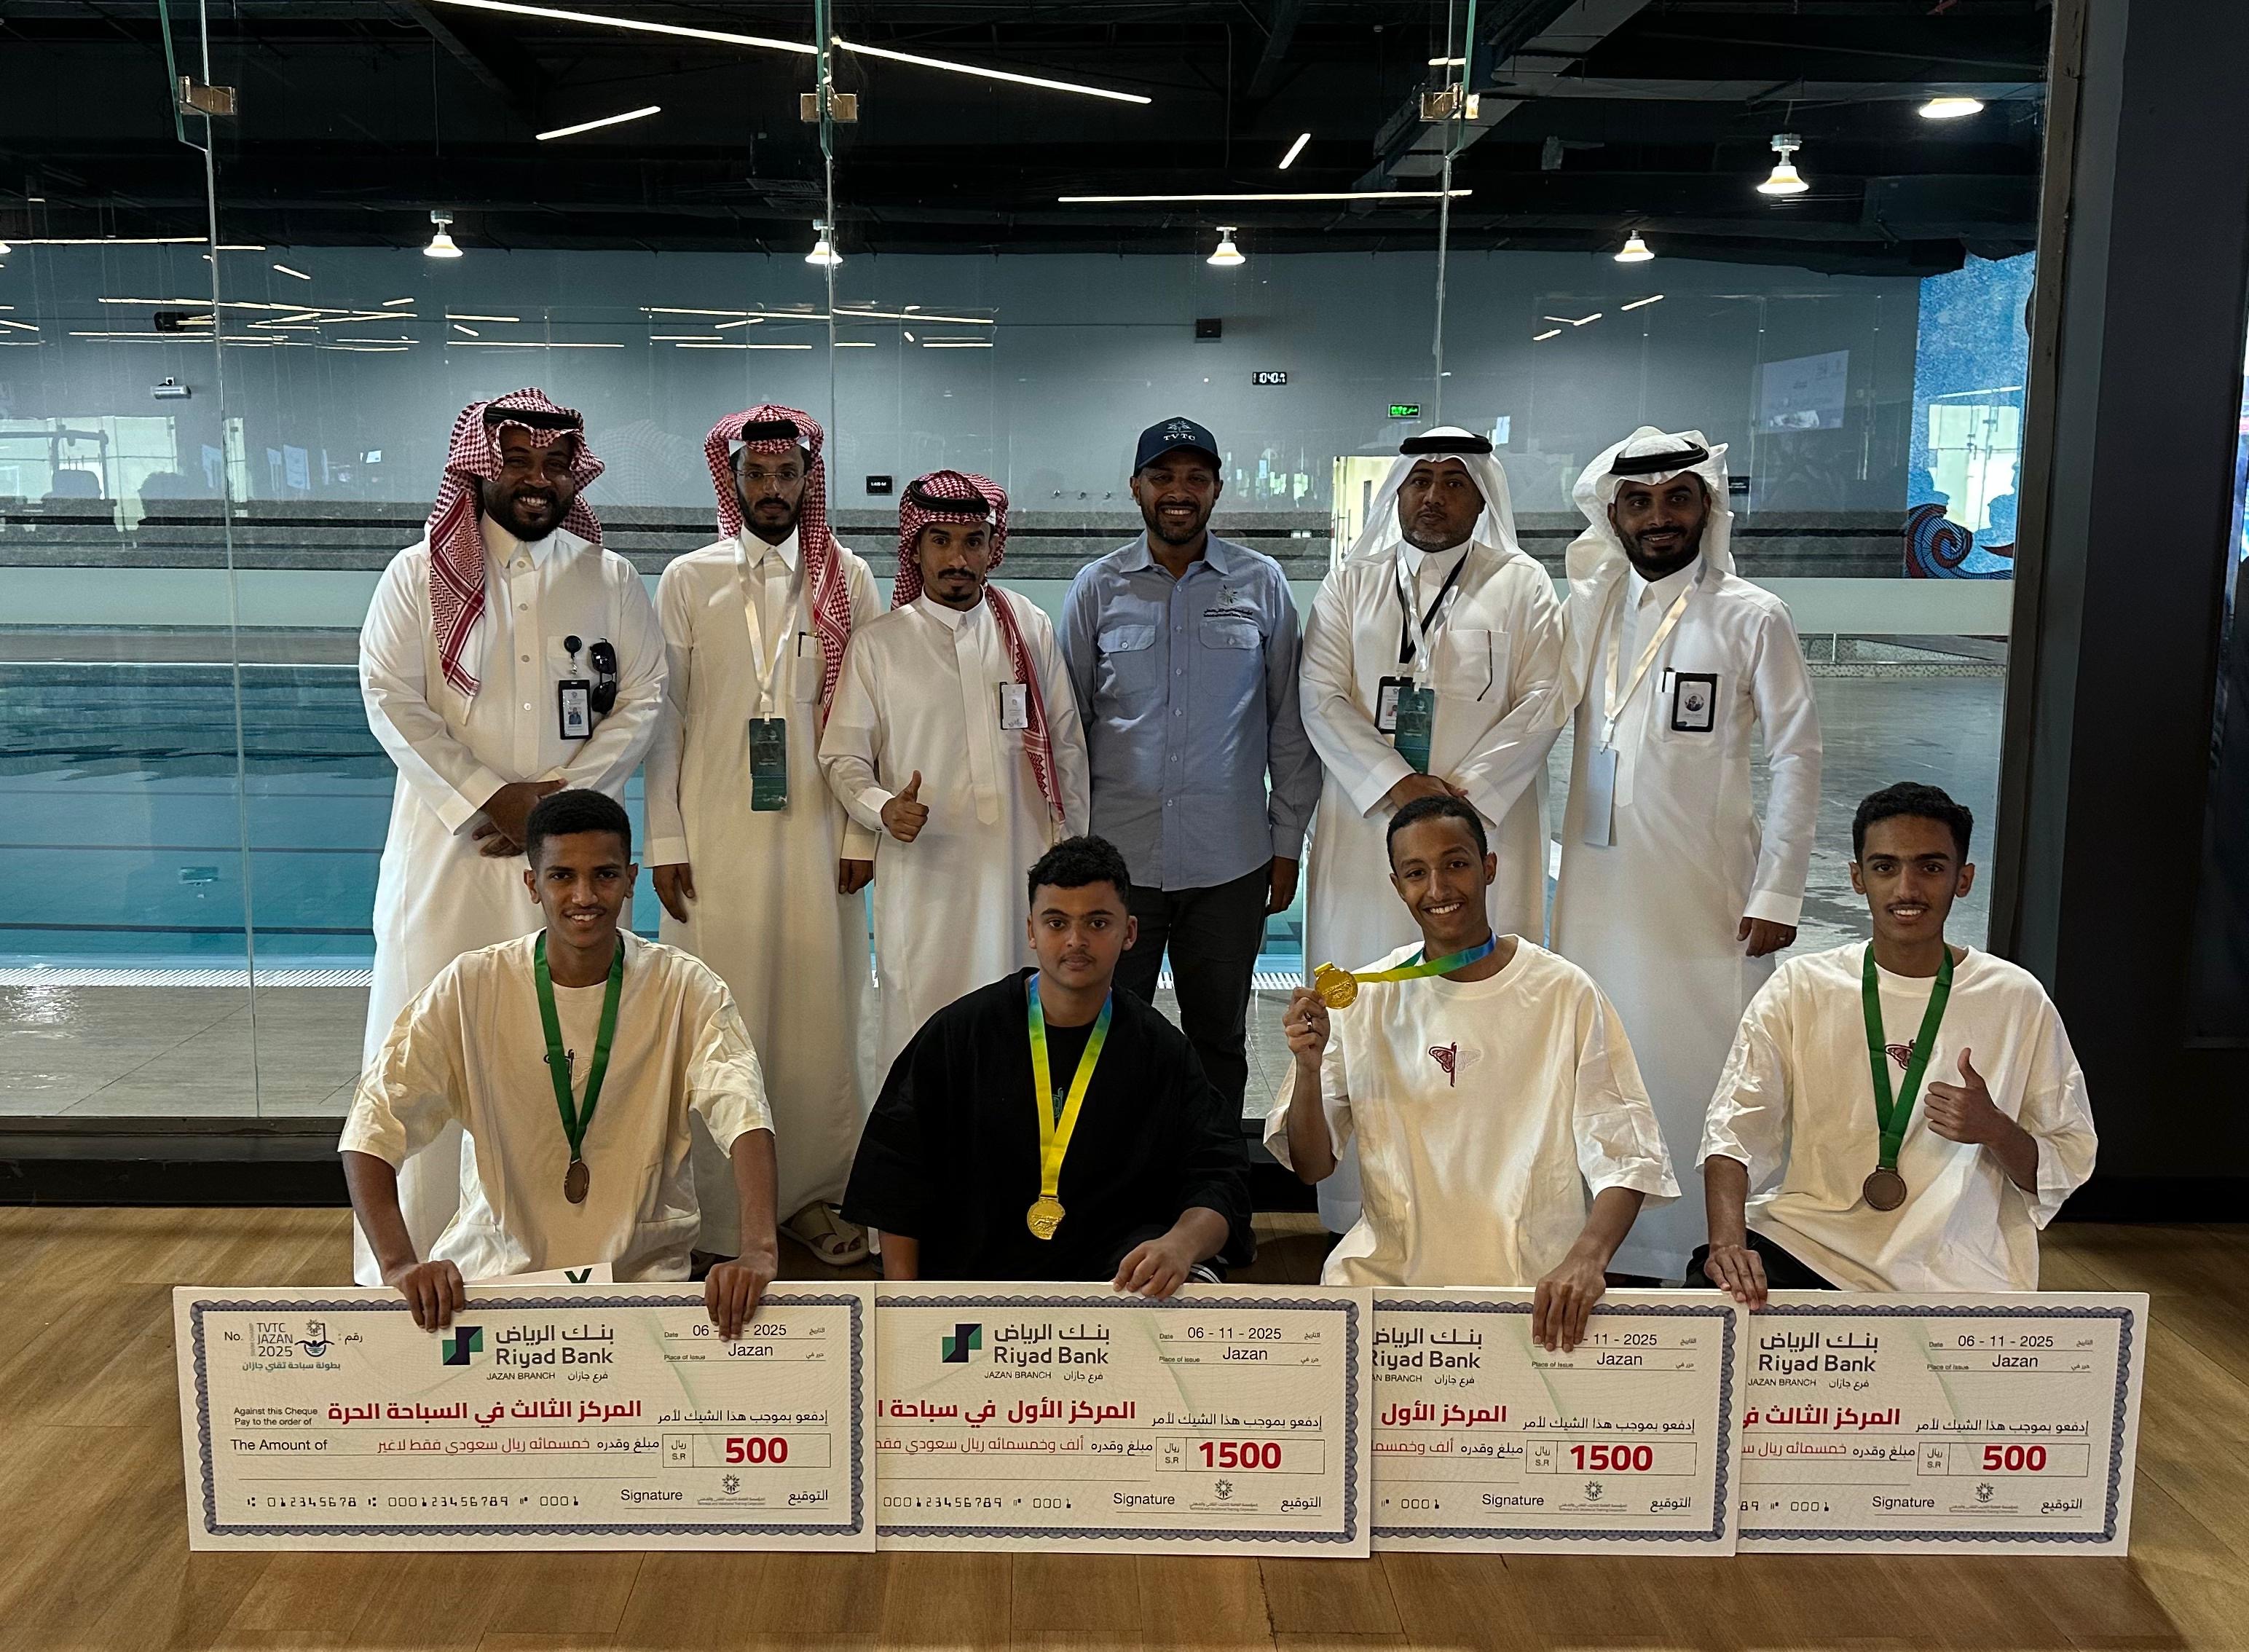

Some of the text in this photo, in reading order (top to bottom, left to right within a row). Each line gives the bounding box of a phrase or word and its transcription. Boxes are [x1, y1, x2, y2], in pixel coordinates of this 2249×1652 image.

[256, 1323, 286, 1332] TVTC
[496, 1324, 614, 1345] بنك الرياض
[693, 1324, 787, 1336] 06 2025
[994, 1323, 1109, 1345] بنك الرياض
[1188, 1327, 1282, 1340] 06 11 2025
[257, 1334, 294, 1345] JAZAN
[344, 1332, 363, 1345] رقم
[1430, 1329, 1481, 1349] بنك
[1594, 1334, 1657, 1345] 11 2025
[1760, 1332, 1878, 1353] بنك الرياض
[1958, 1335, 2054, 1348] 06 11 2025
[258, 1346, 293, 1357] 2025
[728, 1343, 773, 1356] Jazan
[994, 1346, 1108, 1367] Riyad Bank
[1222, 1346, 1268, 1361] Jazan
[496, 1348, 614, 1368] Riyad Bank
[1430, 1350, 1480, 1368] Bank
[1597, 1352, 1642, 1366] Jazan
[1759, 1354, 1876, 1374] Riyad Bank
[1992, 1354, 2039, 1367] Jazan
[242, 1361, 340, 1372] بطولة سباحة تقني جازان
[487, 1372, 515, 1380] JAZAN
[568, 1371, 609, 1383] فرع جازان
[1063, 1371, 1103, 1383] فرع جازان
[1435, 1374, 1474, 1387] فرع جازان
[1829, 1378, 1870, 1391] فرع جازان
[233, 1407, 265, 1417] Against
[285, 1407, 318, 1416] Cheque
[328, 1398, 642, 1428] المركز الثالث في السباحة الحرة
[658, 1409, 827, 1424] إدفعو بموجب هذا الشيك لأمر
[890, 1399, 958, 1422] سباحة
[965, 1400, 996, 1428] في
[1008, 1396, 1062, 1424] الأول
[1068, 1400, 1135, 1424] المركز
[1382, 1400, 1507, 1427] المركز الأول
[1765, 1404, 1900, 1430] المركز الثالث
[235, 1418, 251, 1427] Pay
[1151, 1412, 1322, 1430] إدفعو بموجب هذا الشيك لأمر
[1522, 1416, 1695, 1433] إدفعو بموجب هذا الشيك لأمر
[1915, 1417, 2088, 1435] إدفعو بموجب هذا الشيك لأمر
[230, 1439, 328, 1450] The Amount of
[410, 1439, 441, 1451] فقط
[502, 1438, 526, 1452] ريال
[530, 1437, 590, 1450] خمسمائه
[597, 1438, 629, 1451] وقدره
[634, 1436, 659, 1453] مبلغ
[671, 1439, 687, 1450] ريال
[961, 1437, 985, 1453] ريال
[988, 1437, 1055, 1453] وخمسمائه
[1060, 1435, 1084, 1450] ألف
[1091, 1441, 1123, 1453] وقدره
[1127, 1440, 1153, 1457] مبلغ
[1165, 1443, 1180, 1453] ريال
[1372, 1438, 1523, 1458] مبلغ وقدره ألف وخمسما
[1758, 1442, 1782, 1457] ريال
[1787, 1441, 1847, 1454] خمسمائه
[725, 1437, 788, 1463] 500
[1200, 1441, 1282, 1469] 1500
[1535, 1446, 1551, 1456] ريال
[1853, 1446, 1885, 1458] وقدره
[1889, 1445, 1915, 1460] مبلغ
[1927, 1447, 1942, 1458] ريال
[1570, 1444, 1653, 1472] 1500
[1982, 1445, 2047, 1471] 500
[267, 1496, 578, 1507] 012345678 000123456789 0001
[621, 1489, 683, 1503] Signature
[788, 1489, 828, 1506] التوقيع
[1113, 1492, 1175, 1506] Signature
[1482, 1493, 1544, 1507] Signature
[1872, 1496, 1935, 1510] Signature
[1033, 1498, 1071, 1509] 0001
[1280, 1497, 1321, 1512] التوقيع
[1401, 1498, 1440, 1509] 0001
[1650, 1497, 1691, 1513] التوقيع
[1790, 1502, 1829, 1511] 0001
[2041, 1498, 2082, 1514] التوقيع
